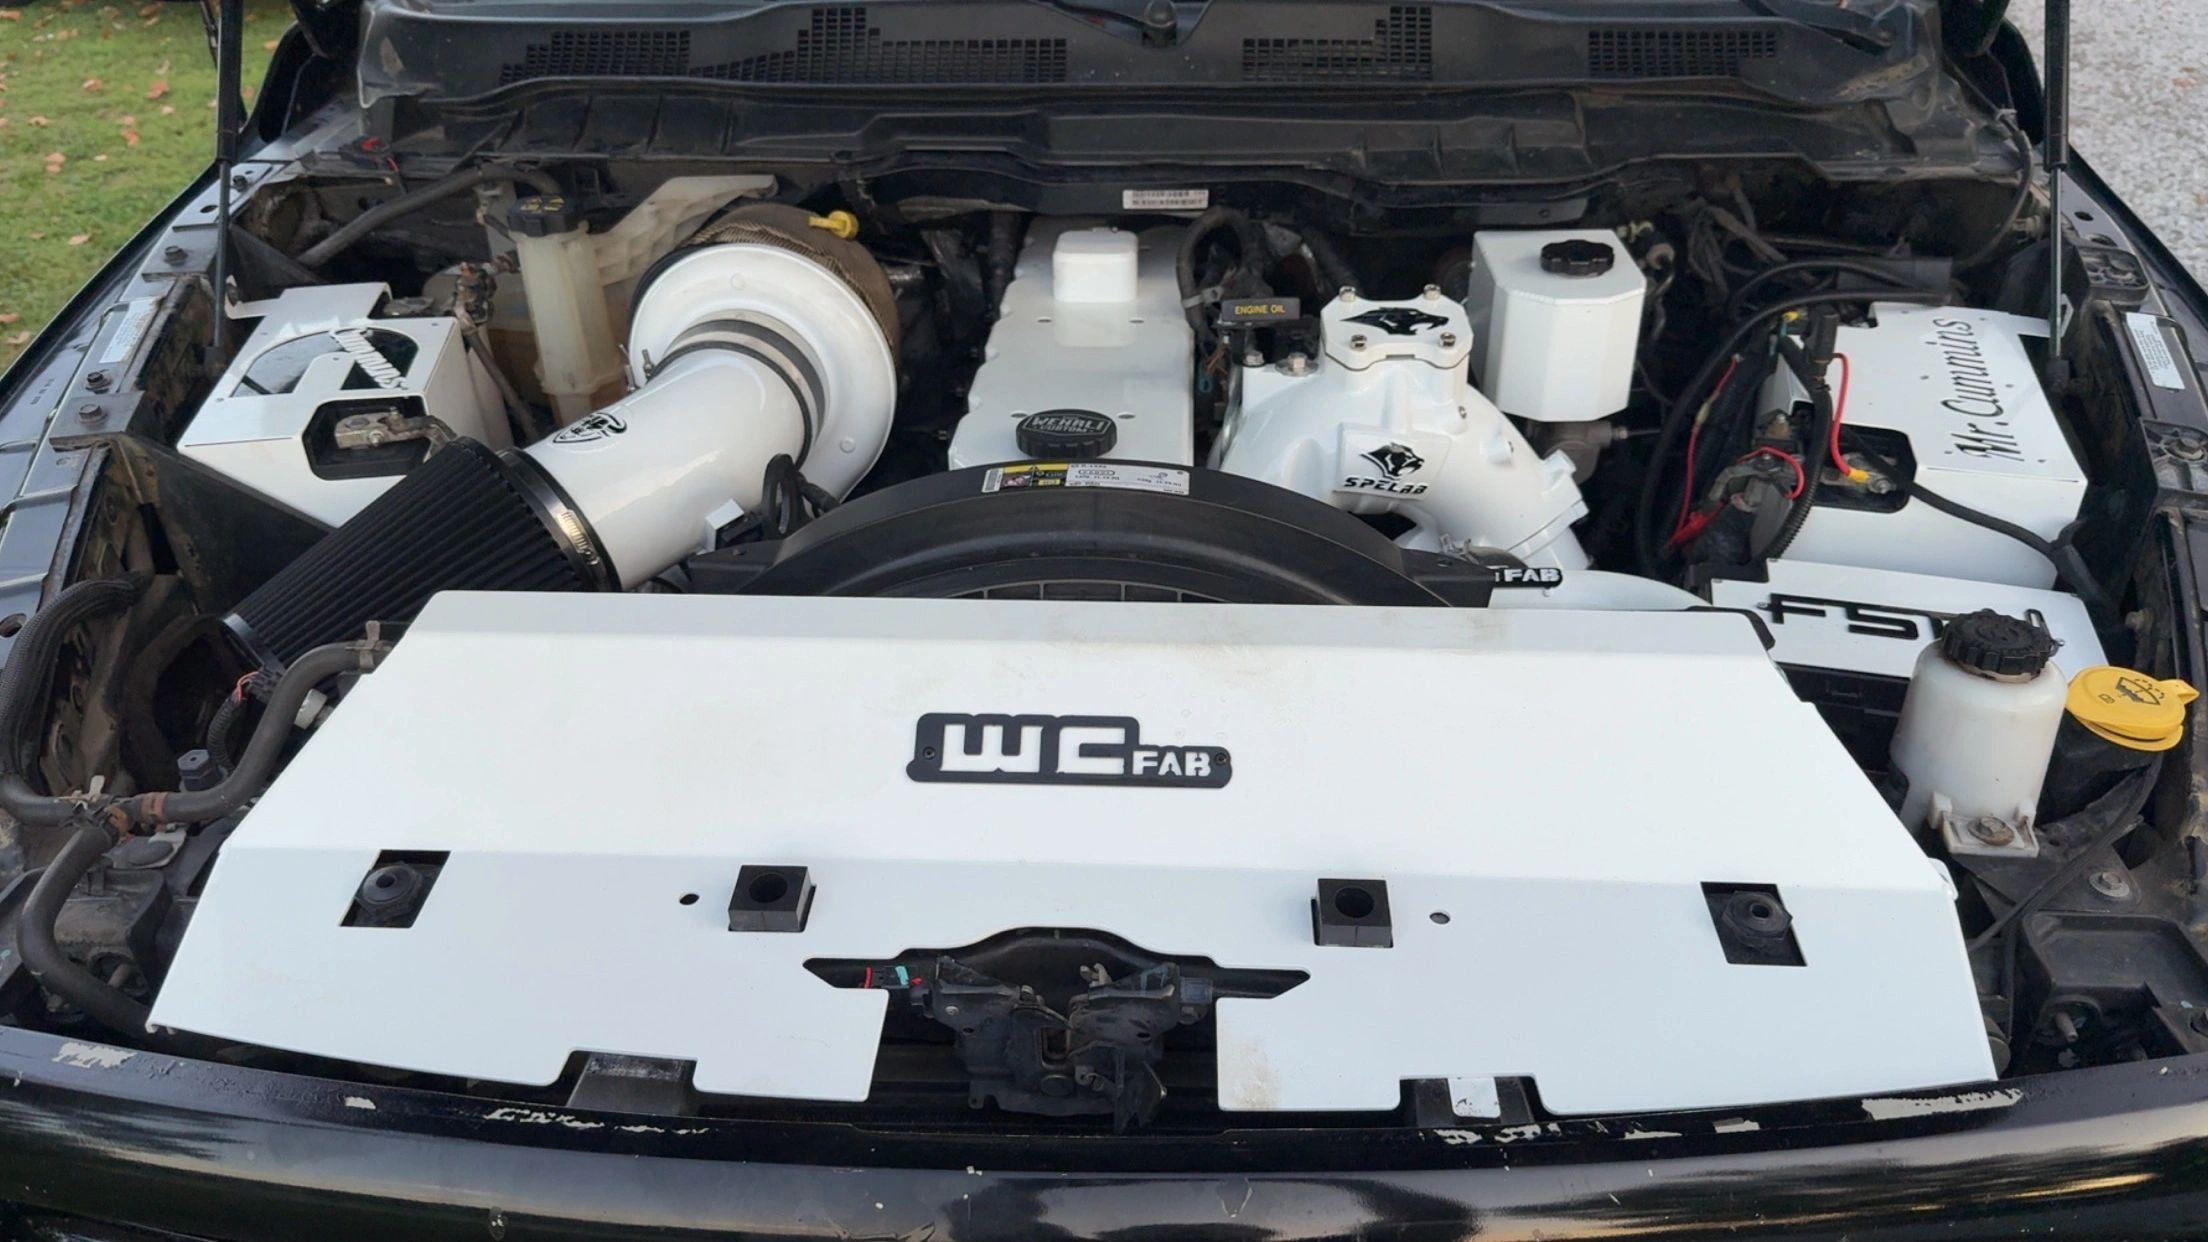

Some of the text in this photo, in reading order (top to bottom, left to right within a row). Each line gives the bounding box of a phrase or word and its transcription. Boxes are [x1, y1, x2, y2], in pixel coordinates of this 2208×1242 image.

[1234, 304, 1286, 315] ENGINE OIL
[1343, 476, 1429, 495] SPELAB
[1503, 568, 1560, 582] FAB
[1131, 749, 1212, 777] FAB
